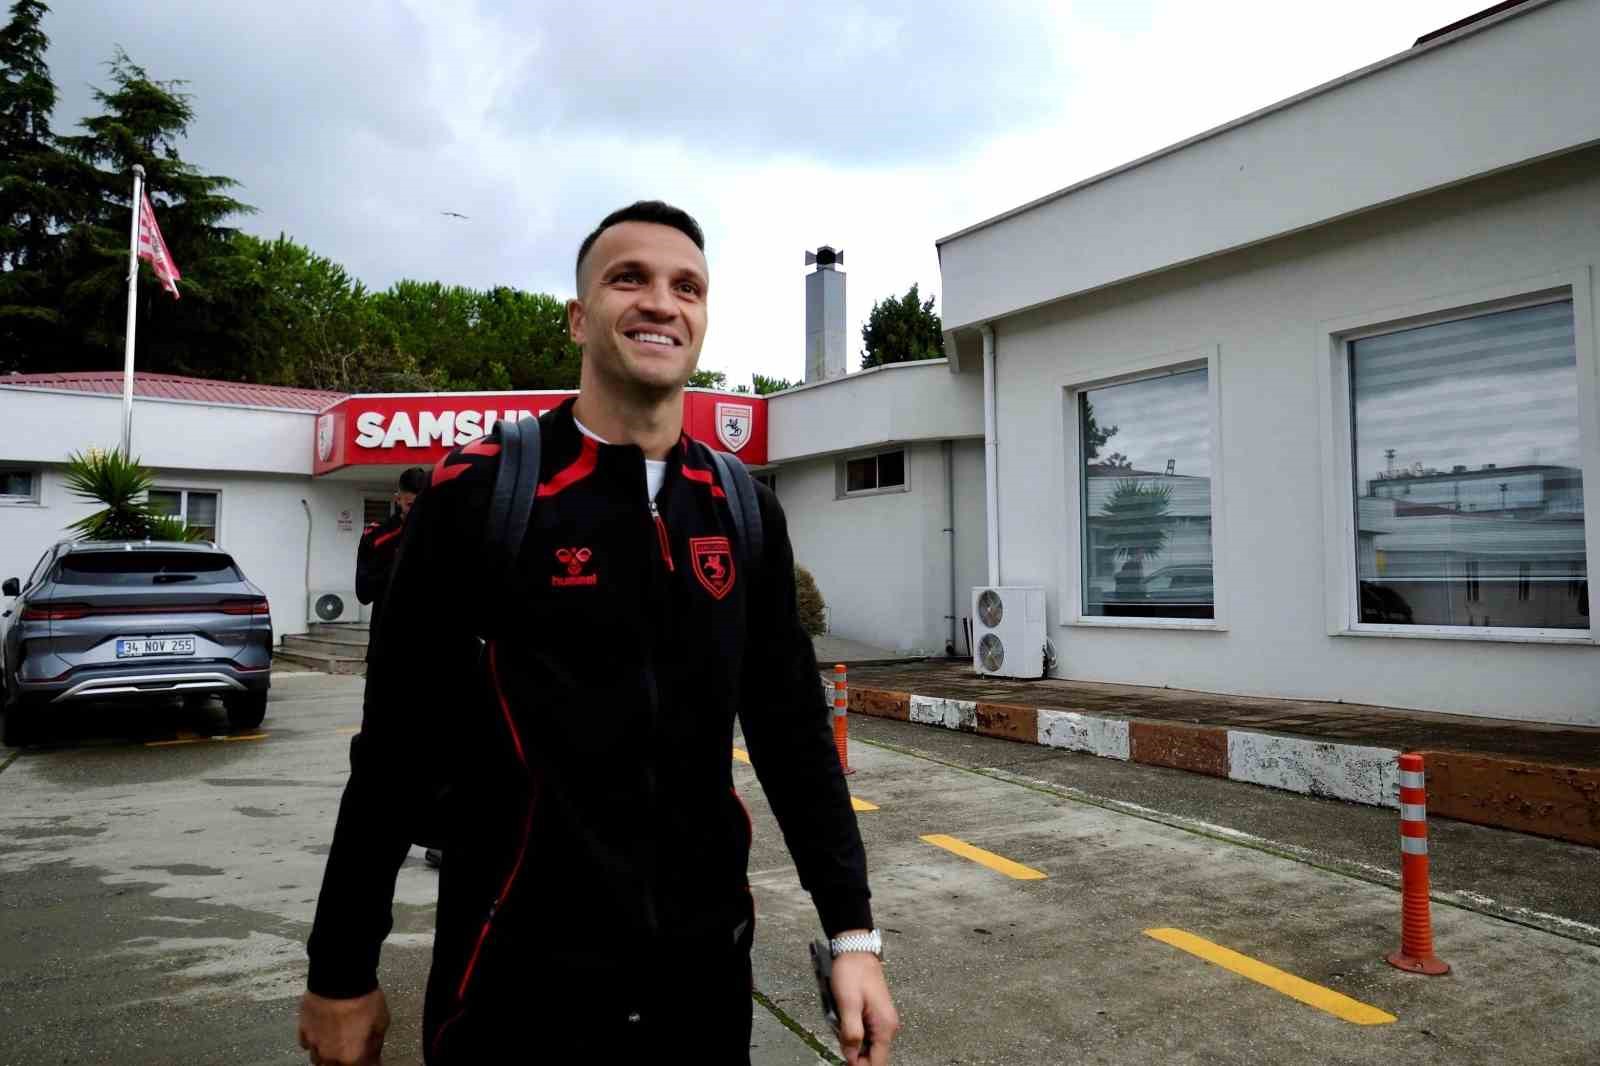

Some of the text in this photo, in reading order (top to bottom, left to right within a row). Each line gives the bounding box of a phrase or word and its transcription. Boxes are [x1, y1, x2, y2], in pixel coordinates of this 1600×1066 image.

[125, 640, 192, 653] 34 NOV 255
